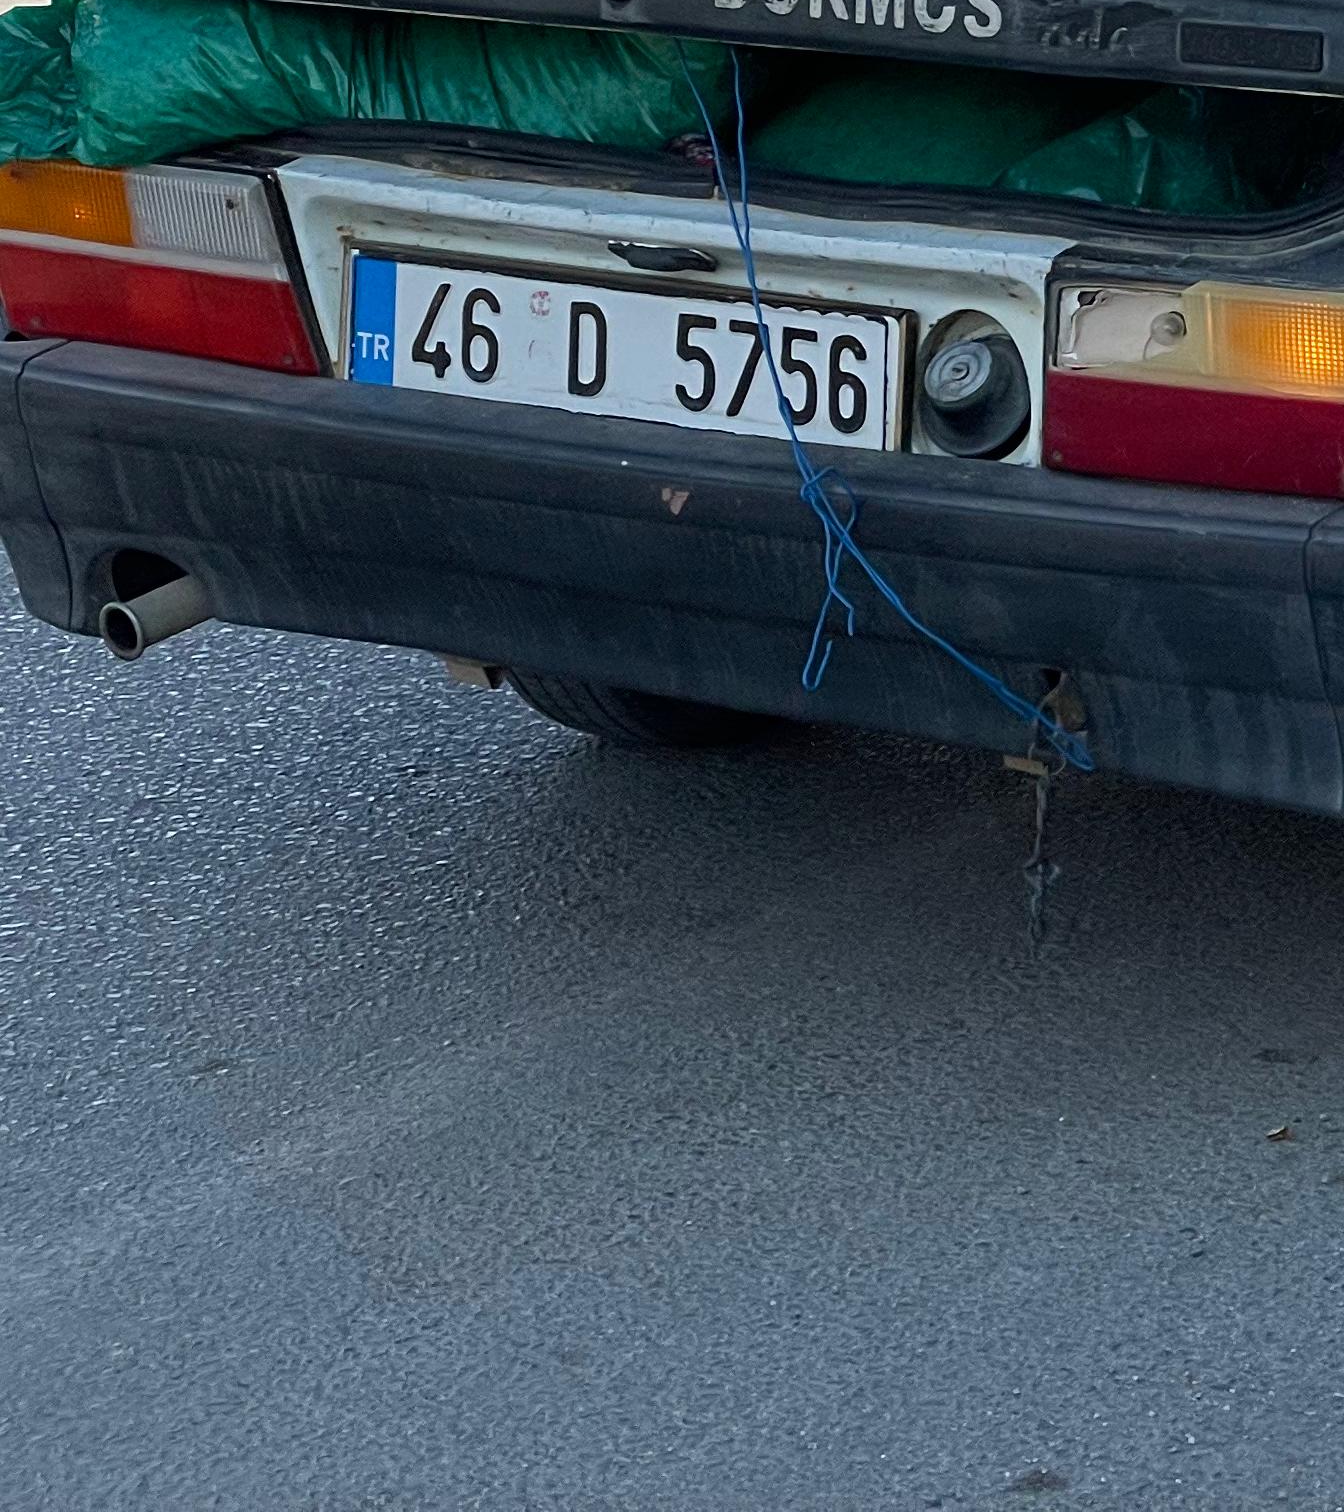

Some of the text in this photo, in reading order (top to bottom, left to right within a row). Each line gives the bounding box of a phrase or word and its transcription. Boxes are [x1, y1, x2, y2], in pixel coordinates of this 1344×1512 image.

[356, 331, 391, 362] TR
[412, 283, 868, 434] 46 D 5756
